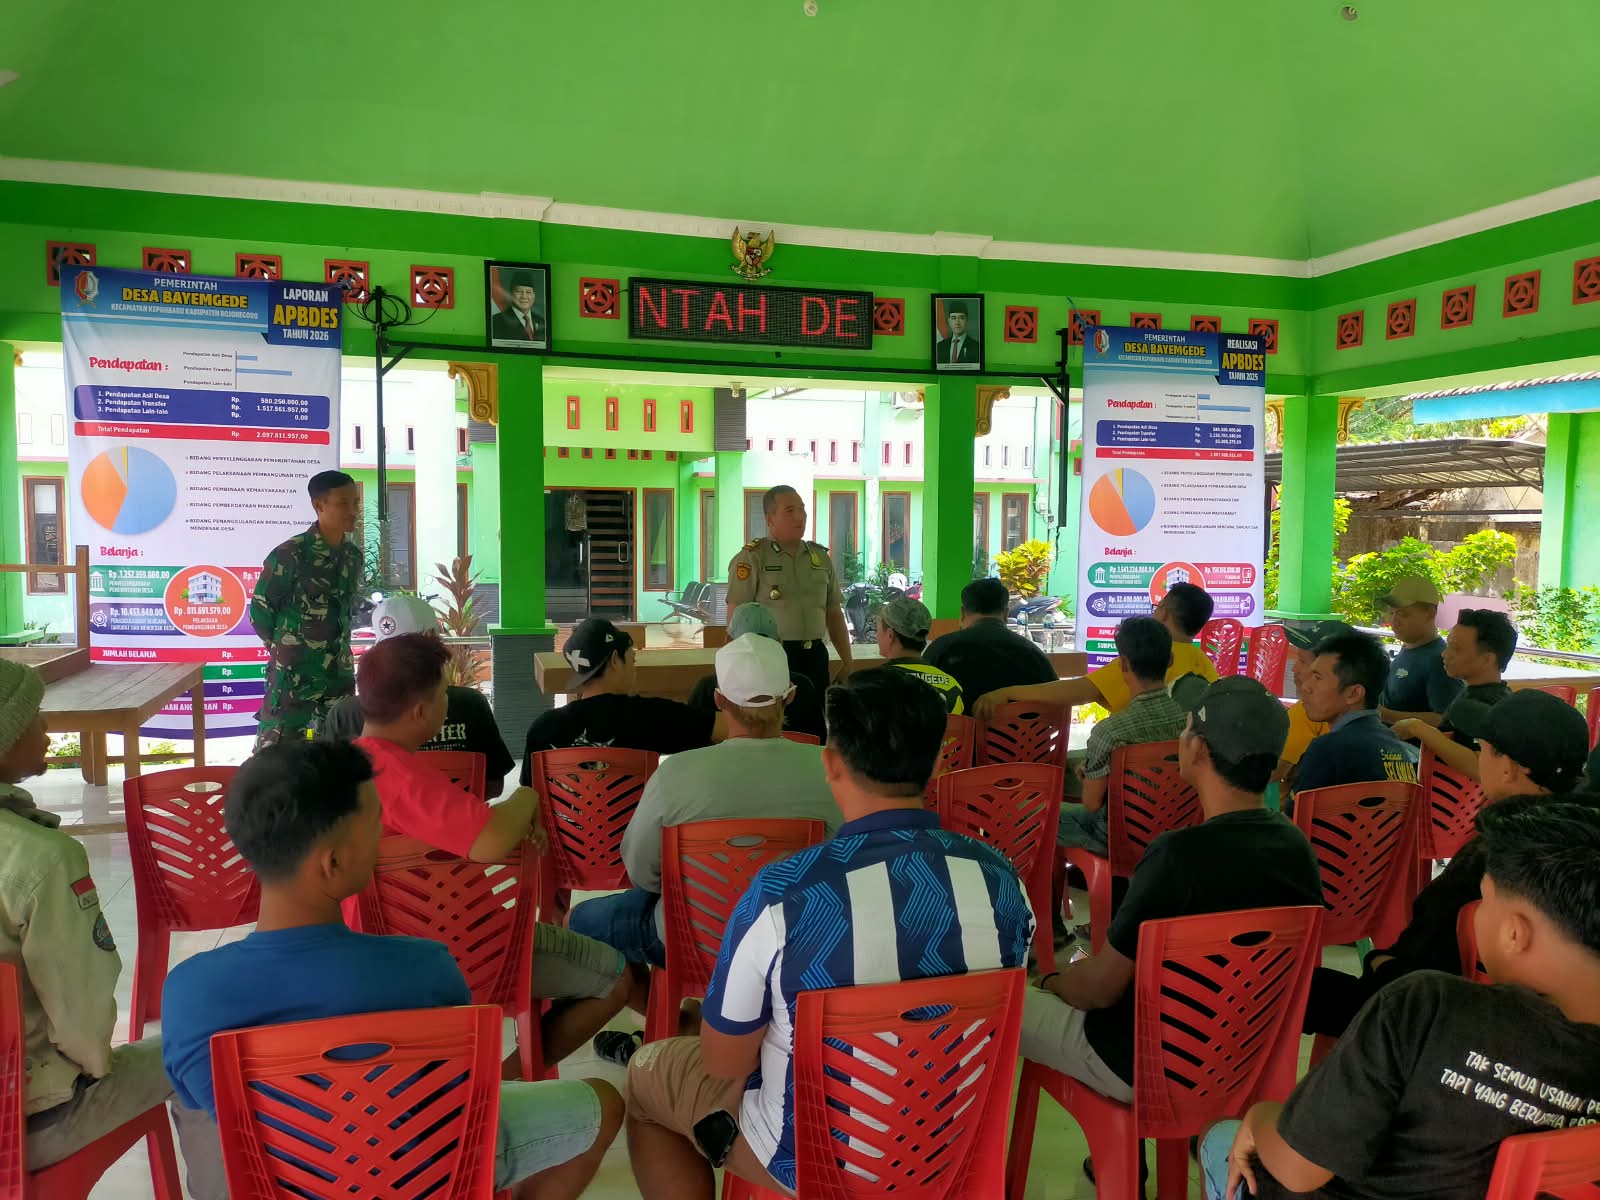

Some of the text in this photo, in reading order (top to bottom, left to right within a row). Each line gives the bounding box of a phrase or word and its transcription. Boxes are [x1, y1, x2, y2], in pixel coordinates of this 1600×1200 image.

[154, 278, 218, 291] PEMERINTAH
[122, 287, 248, 309] DESA BAYEMGEDE
[283, 288, 328, 302] LAPORAN
[111, 303, 148, 313] KECAMATAN
[185, 307, 220, 317] KABUPATEN
[273, 303, 339, 330] APBDES
[638, 287, 859, 338] NTAH DE
[282, 328, 329, 341] TAHUN 2026
[1144, 333, 1186, 343] PEMERINTAH
[1123, 341, 1206, 357] DESA BAYEMGEDE
[1227, 339, 1258, 350] REALISASI
[89, 356, 162, 372] Pendapatan
[1222, 352, 1264, 371] APBDES
[1228, 371, 1246, 380] TAHUN
[105, 391, 141, 399] Pendapatan
[1107, 398, 1153, 411] Pendapatan
[113, 427, 150, 435] Pendapatan
[100, 546, 138, 559] Belanja
[1104, 547, 1133, 557] Belanja
[102, 649, 128, 658] JUMLAH
[128, 650, 157, 659] BELANJA
[221, 651, 234, 659] Rp.
[221, 668, 234, 676] Rp.
[907, 672, 950, 685] MGEDE
[221, 686, 234, 694] Rp.
[222, 703, 234, 711] Rp.
[1464, 1050, 1492, 1072] TAK
[1493, 1062, 1537, 1094] SEMUA
[1440, 1068, 1473, 1095] TAPI
[1474, 1082, 1508, 1110] YANG
